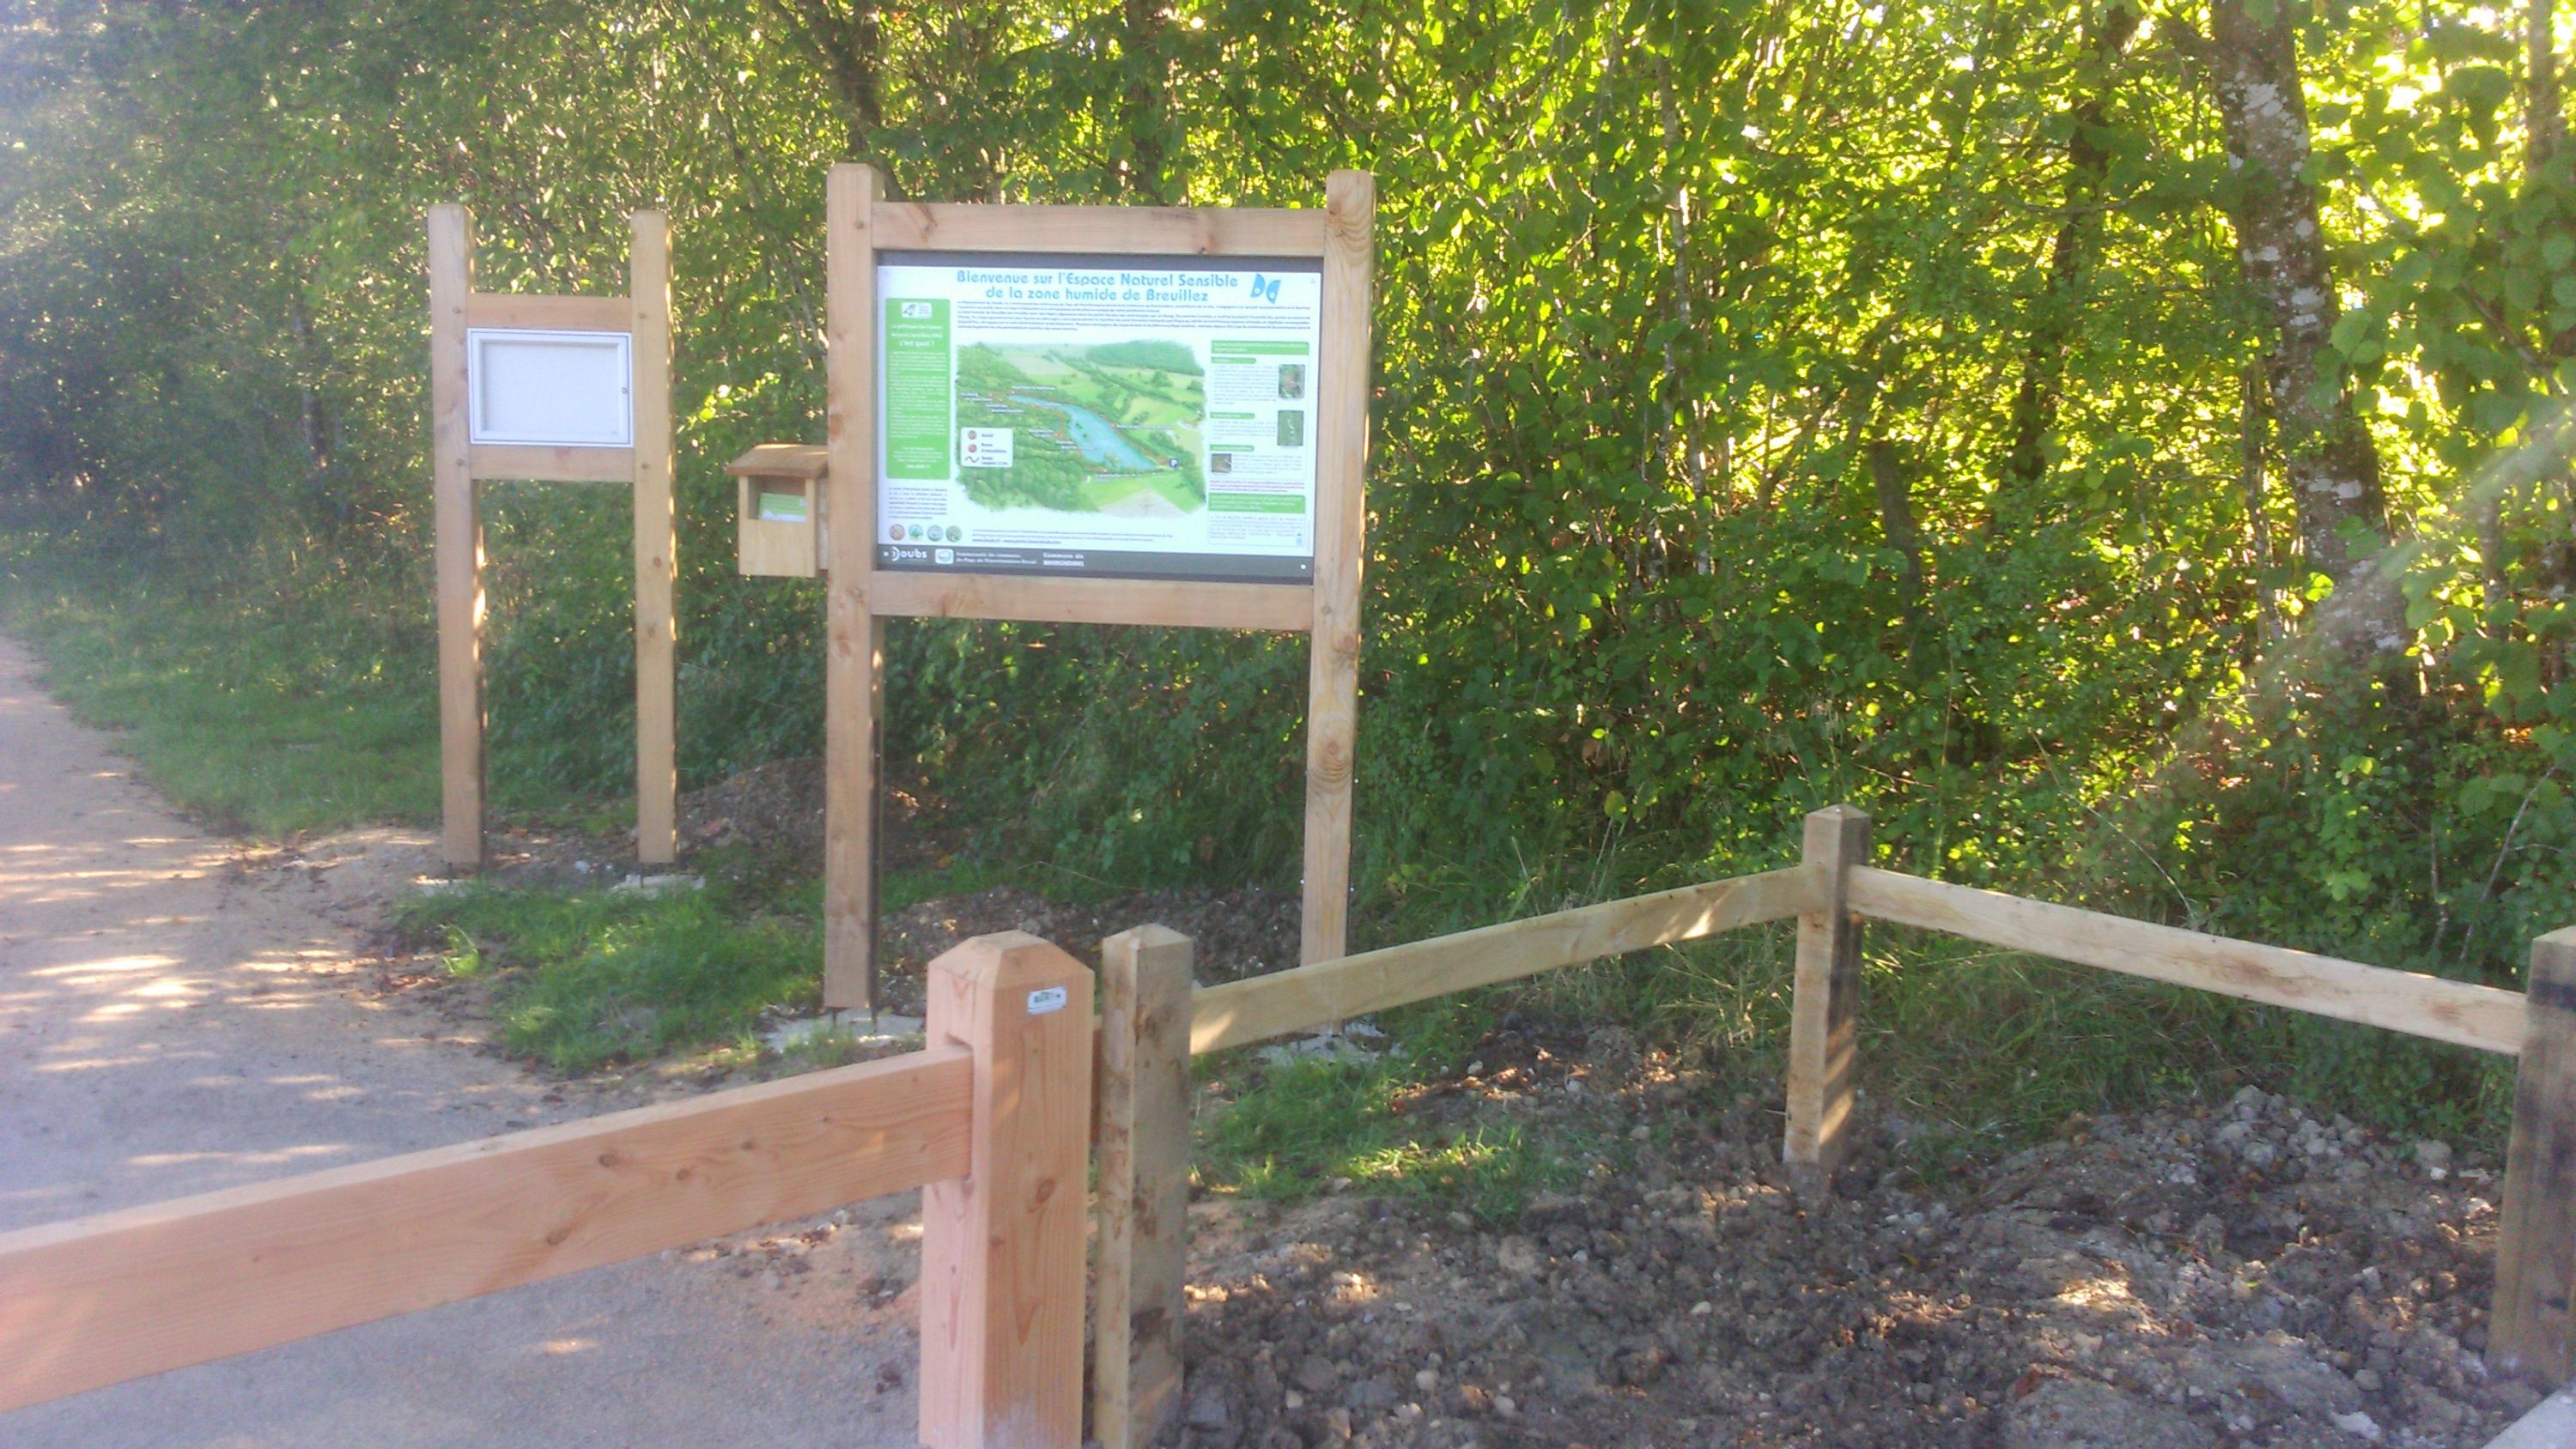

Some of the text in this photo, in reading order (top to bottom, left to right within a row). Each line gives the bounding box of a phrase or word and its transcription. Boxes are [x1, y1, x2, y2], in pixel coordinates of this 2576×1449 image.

[957, 270, 1238, 287] Bienvenue sur l'Espace Naturel Sensible
[986, 286, 1208, 301] de la zone humide de Breuillez
